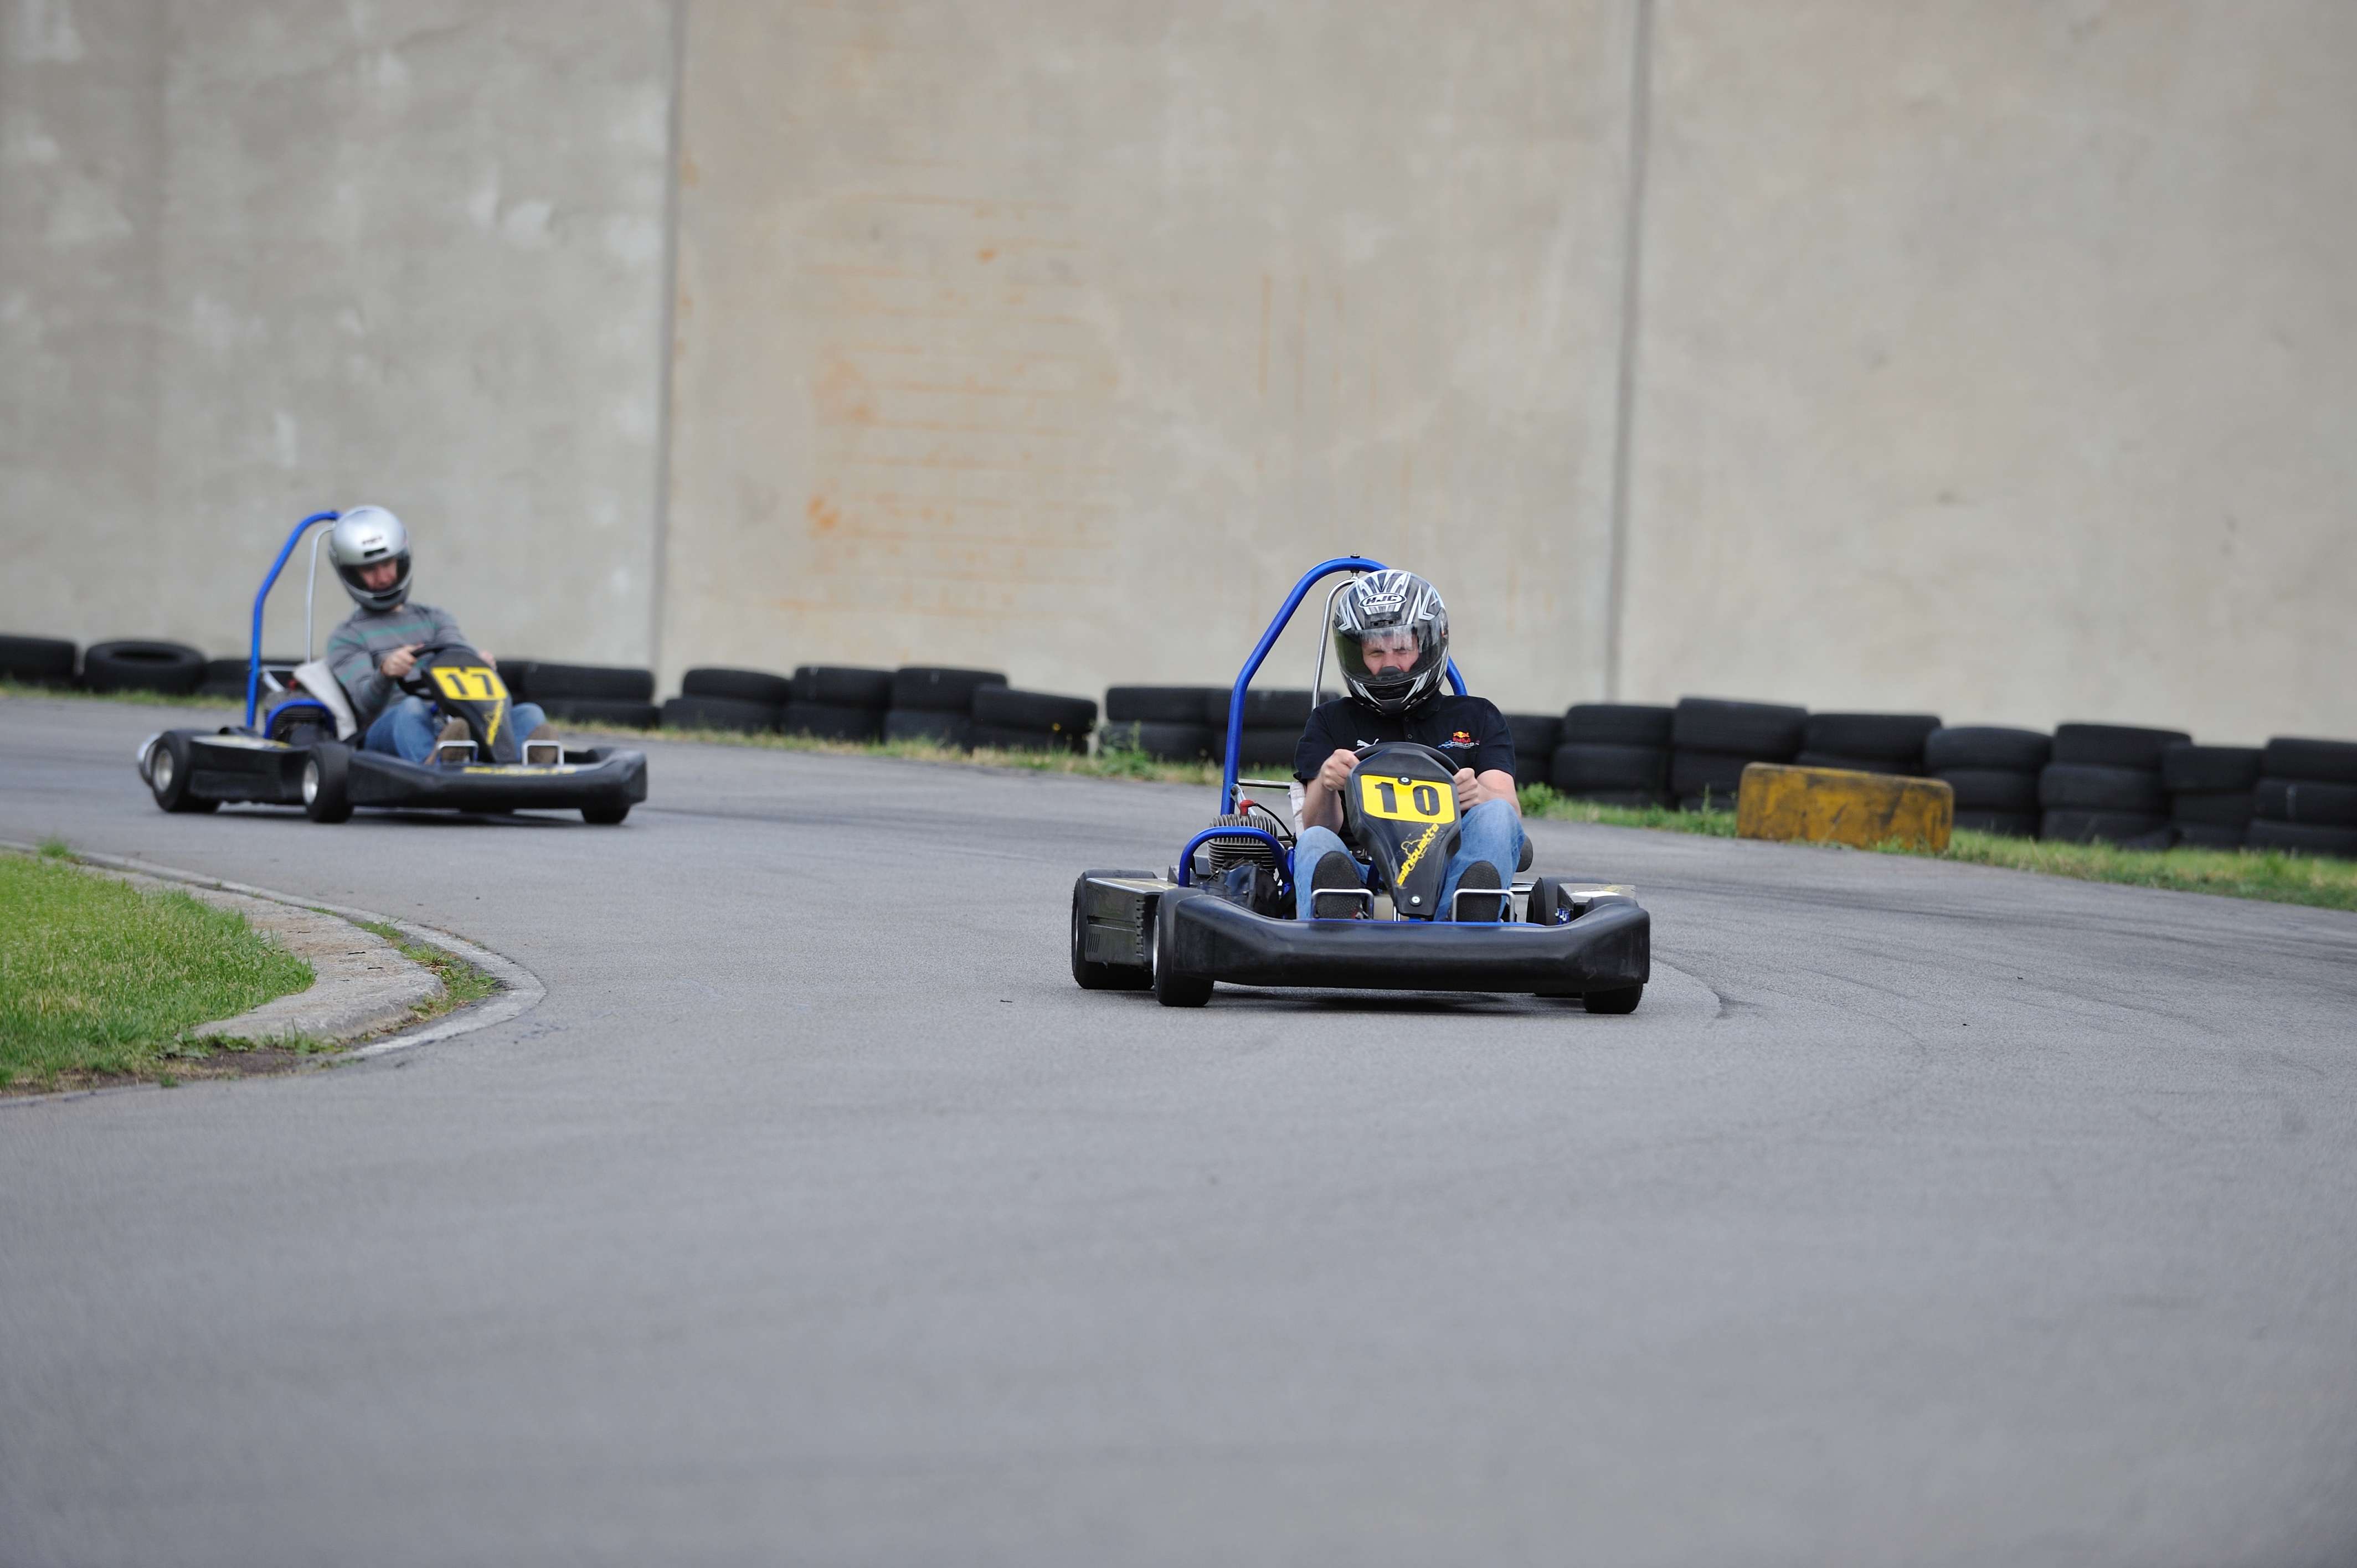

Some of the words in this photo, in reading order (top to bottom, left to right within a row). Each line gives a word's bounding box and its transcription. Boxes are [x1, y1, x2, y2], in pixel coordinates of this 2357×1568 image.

[1366, 595, 1398, 605] HJC
[447, 674, 493, 695] 17
[1375, 782, 1440, 816] 10
